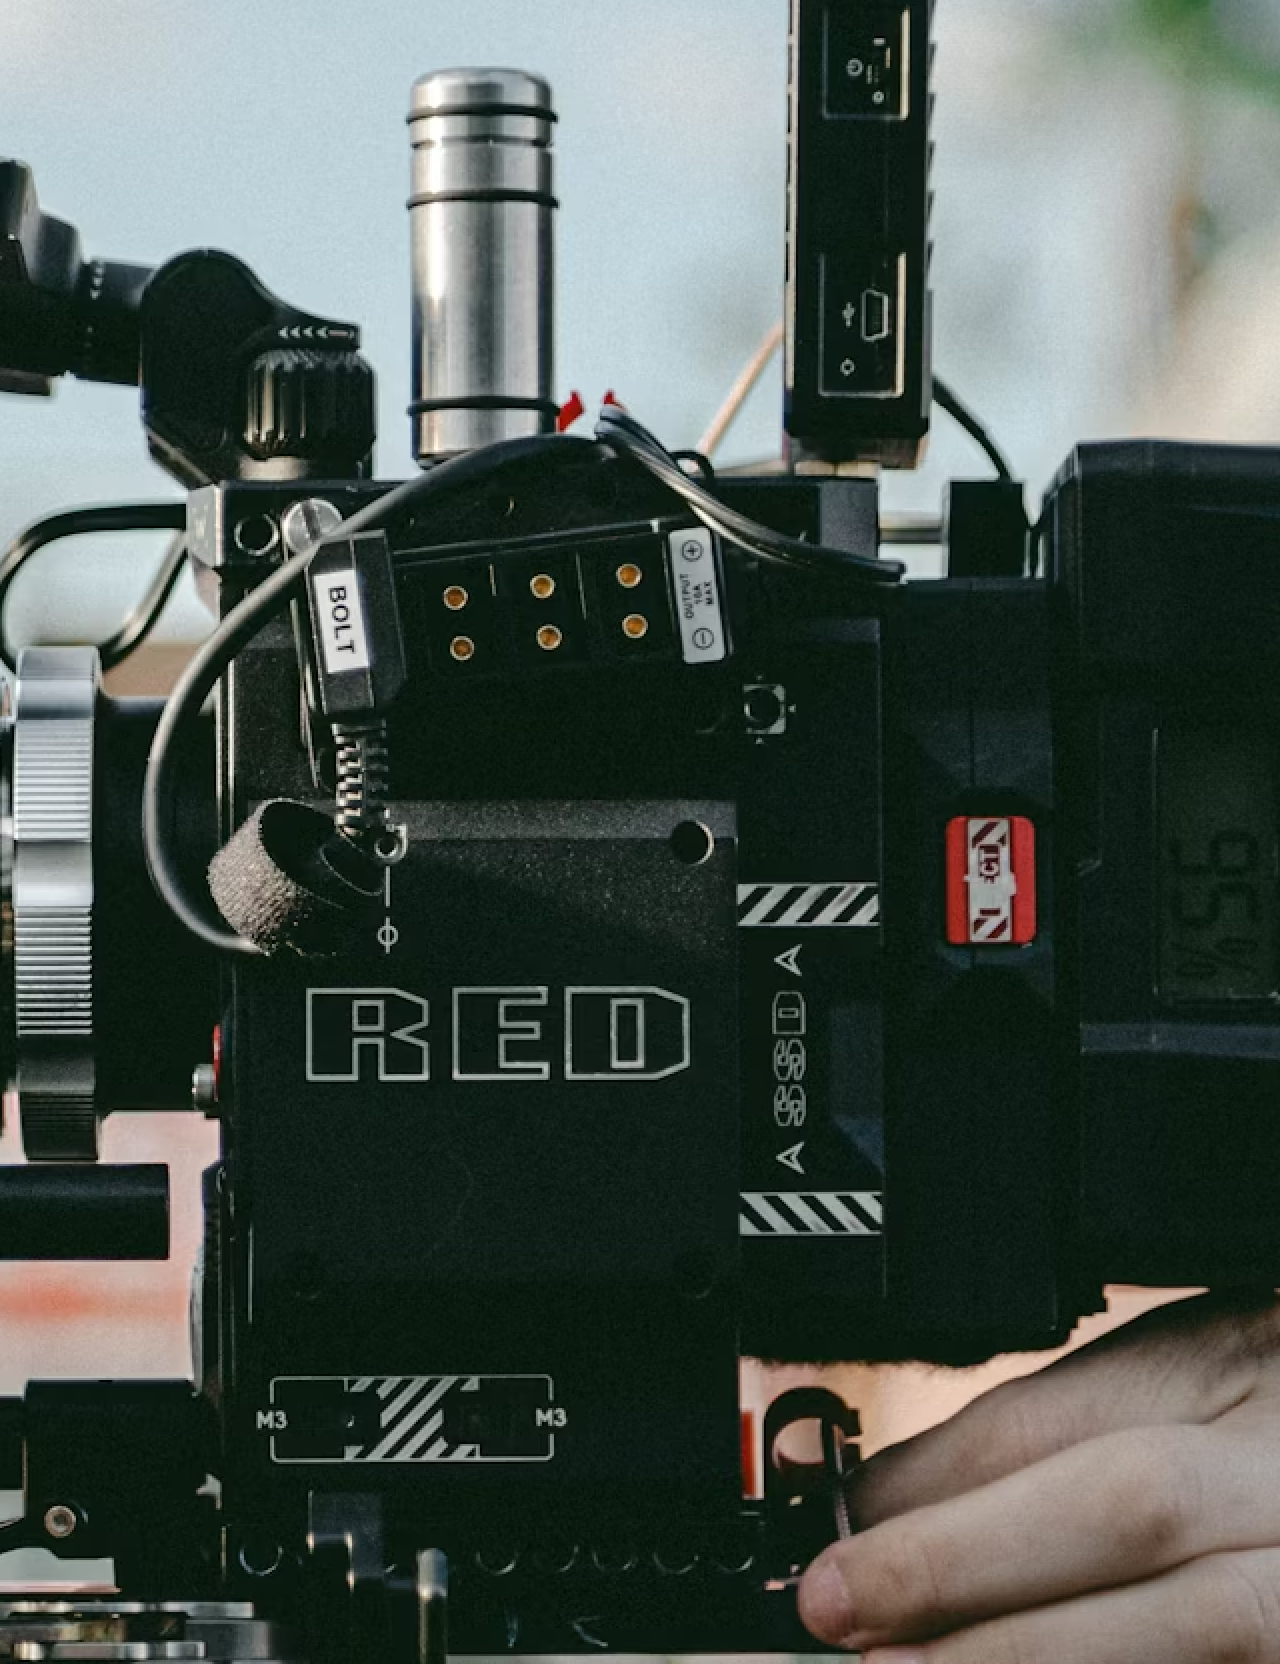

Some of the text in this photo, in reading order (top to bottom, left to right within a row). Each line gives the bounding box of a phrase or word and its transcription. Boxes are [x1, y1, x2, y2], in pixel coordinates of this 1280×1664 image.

[679, 574, 694, 620] OUTPUT
[703, 580, 714, 606] MAX
[328, 586, 356, 654] BOLT
[306, 986, 690, 1081] RED
[772, 991, 806, 1127] SSD
[255, 1409, 289, 1430] M3
[535, 1407, 568, 1428] M3
